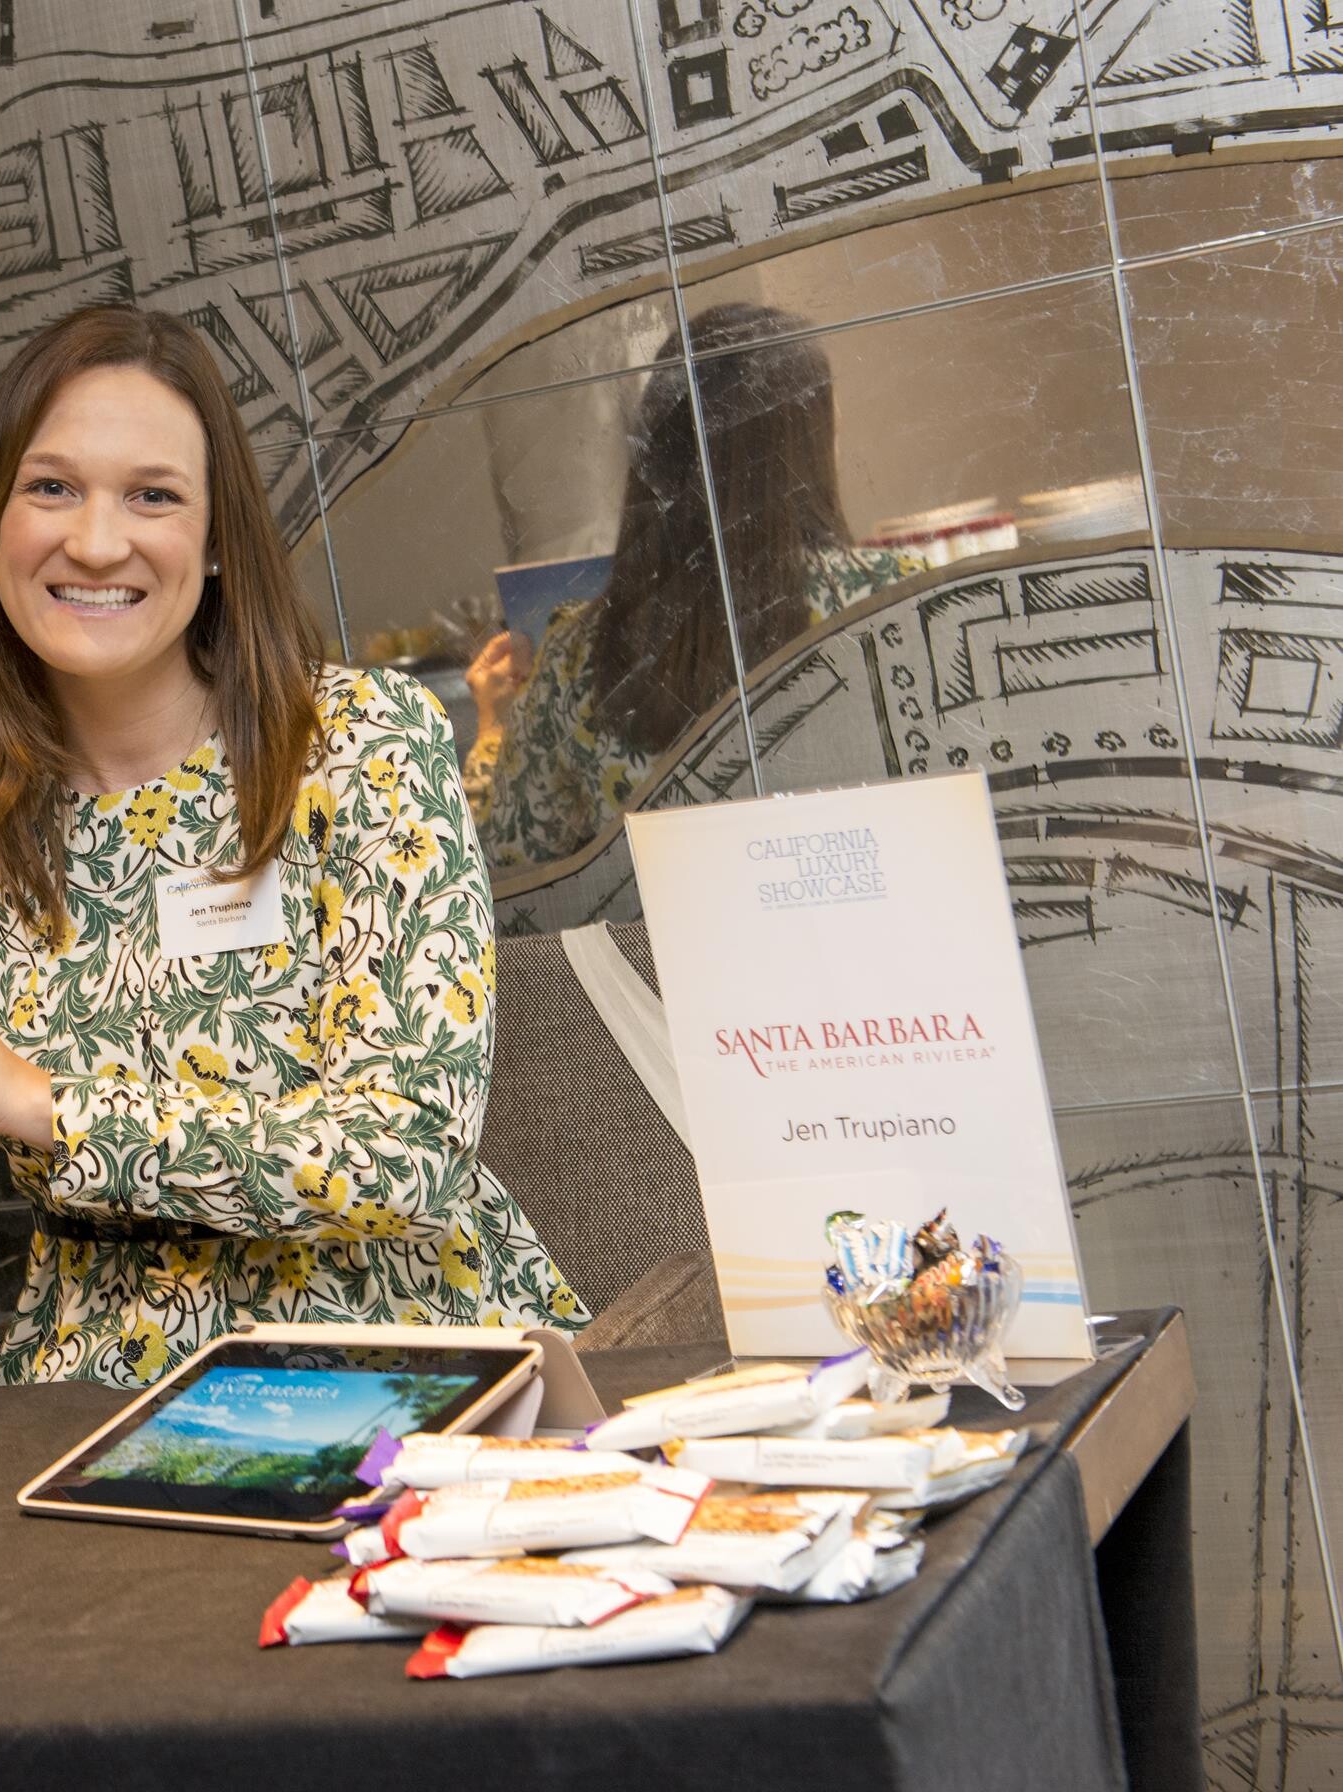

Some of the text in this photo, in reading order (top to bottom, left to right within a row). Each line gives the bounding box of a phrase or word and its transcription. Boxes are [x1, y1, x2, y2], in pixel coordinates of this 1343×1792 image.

[746, 828, 879, 861] CALIFORNIA
[796, 850, 879, 877] LUXURY
[758, 872, 887, 903] SHOWCASE
[190, 900, 252, 917] Jen Trupiano
[196, 914, 247, 928] Santa Barbara
[715, 1013, 985, 1079] SANTA BARBARA
[765, 1060, 799, 1072] THE
[809, 1053, 904, 1070] AMERICAN
[782, 1114, 956, 1142] Jen Trupiano
